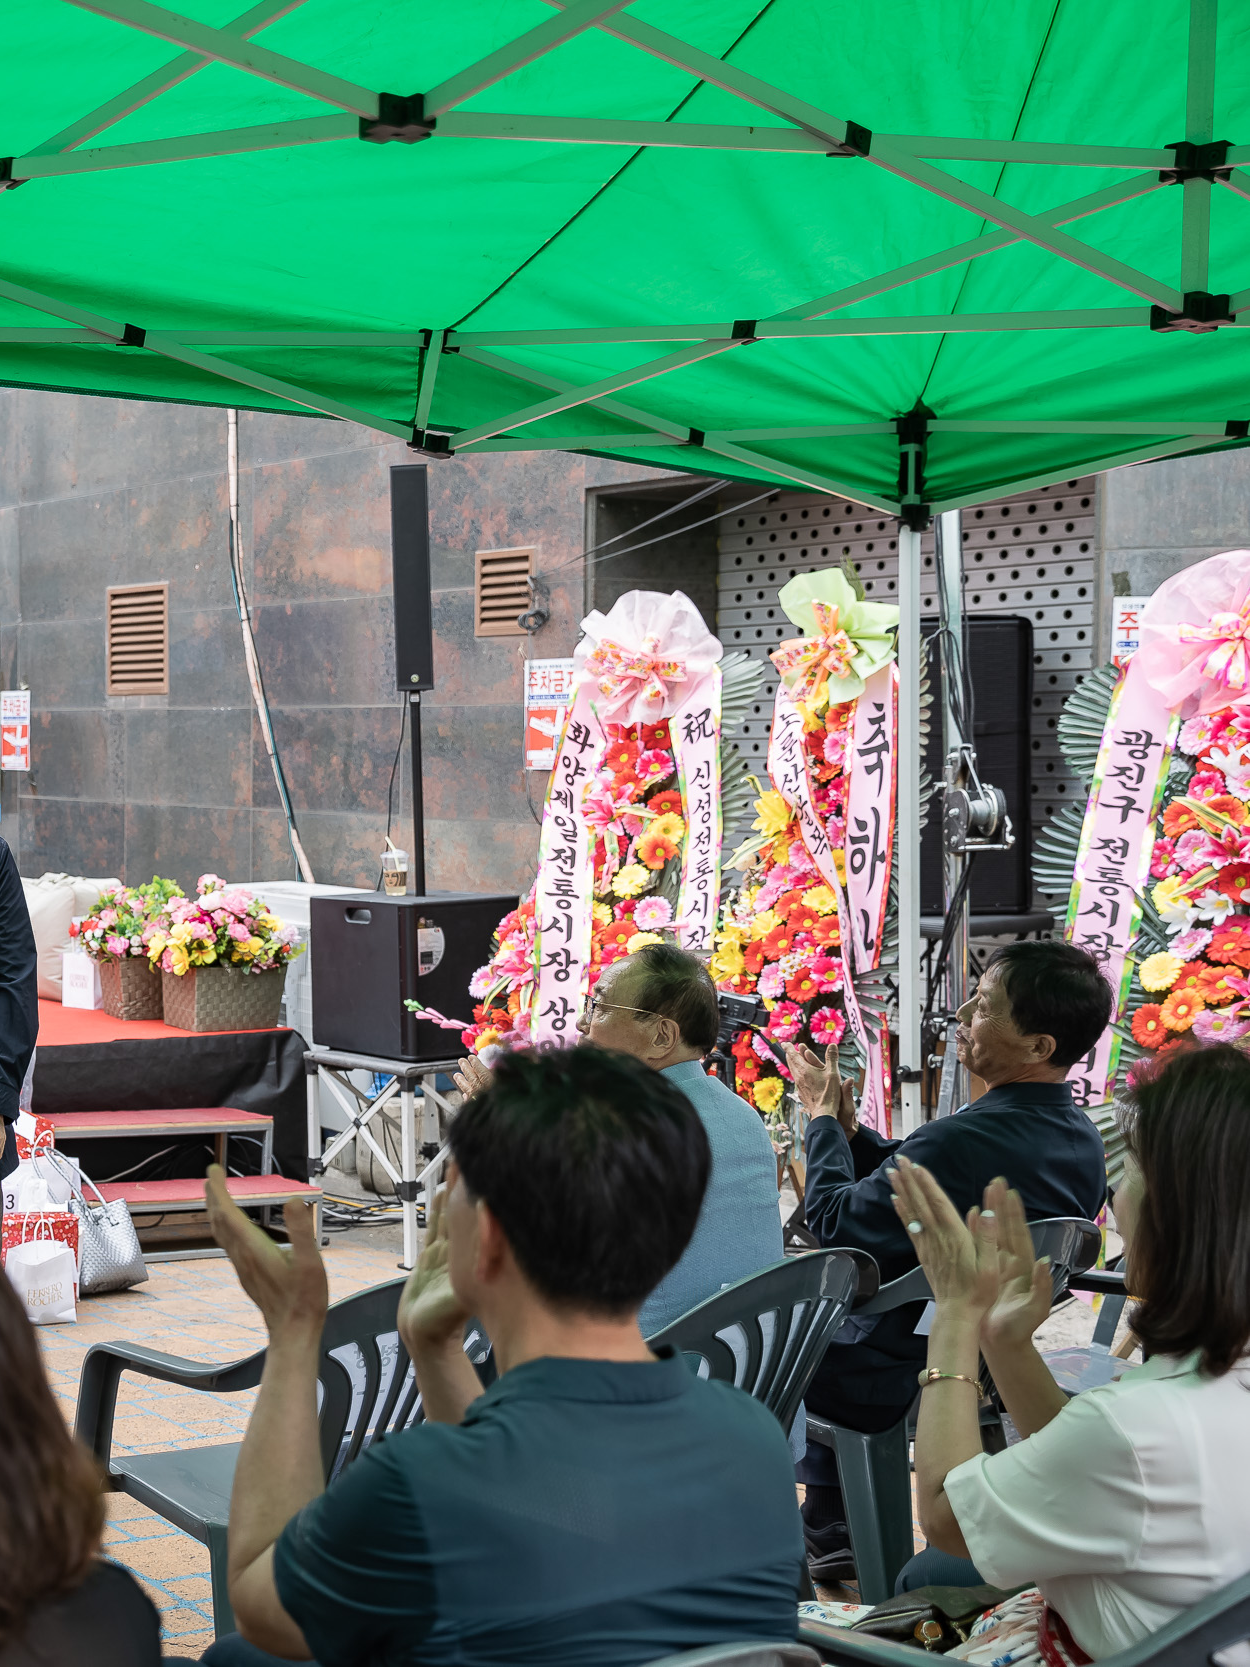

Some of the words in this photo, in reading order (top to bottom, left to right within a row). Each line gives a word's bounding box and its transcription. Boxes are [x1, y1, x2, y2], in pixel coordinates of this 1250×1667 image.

[1100, 729, 1162, 825] 광진구
[541, 720, 595, 983] 화양제일전통시장
[685, 760, 714, 949] 신성전통시장
[1078, 837, 1133, 962] 전통시장
[27, 1281, 63, 1298] FERRERO
[27, 1291, 63, 1307] ROCHER
